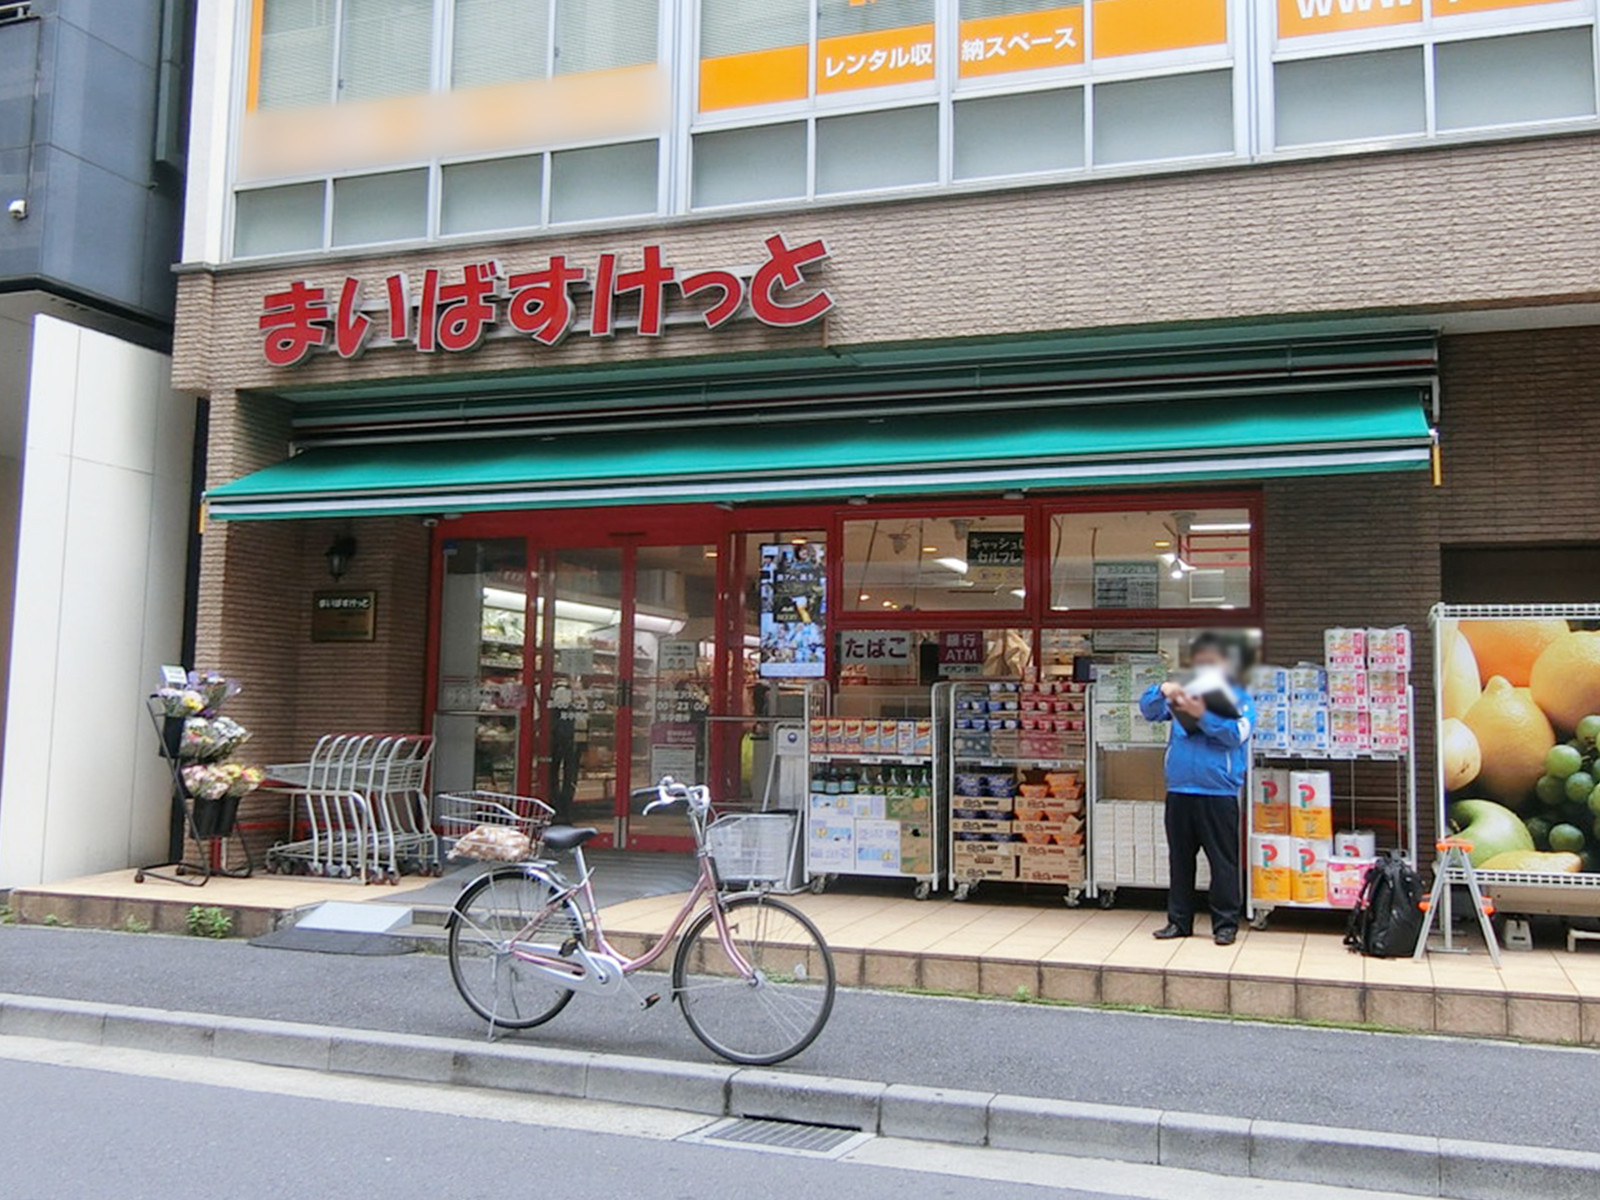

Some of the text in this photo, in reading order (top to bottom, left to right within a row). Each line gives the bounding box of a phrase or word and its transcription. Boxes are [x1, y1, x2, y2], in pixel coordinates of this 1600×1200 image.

[825, 27, 1077, 78] レンタル収 納スペース
[259, 233, 836, 368] まいばすけっと
[845, 637, 907, 658] たばこ
[946, 633, 976, 648] 銀行
[945, 649, 977, 661] ATM
